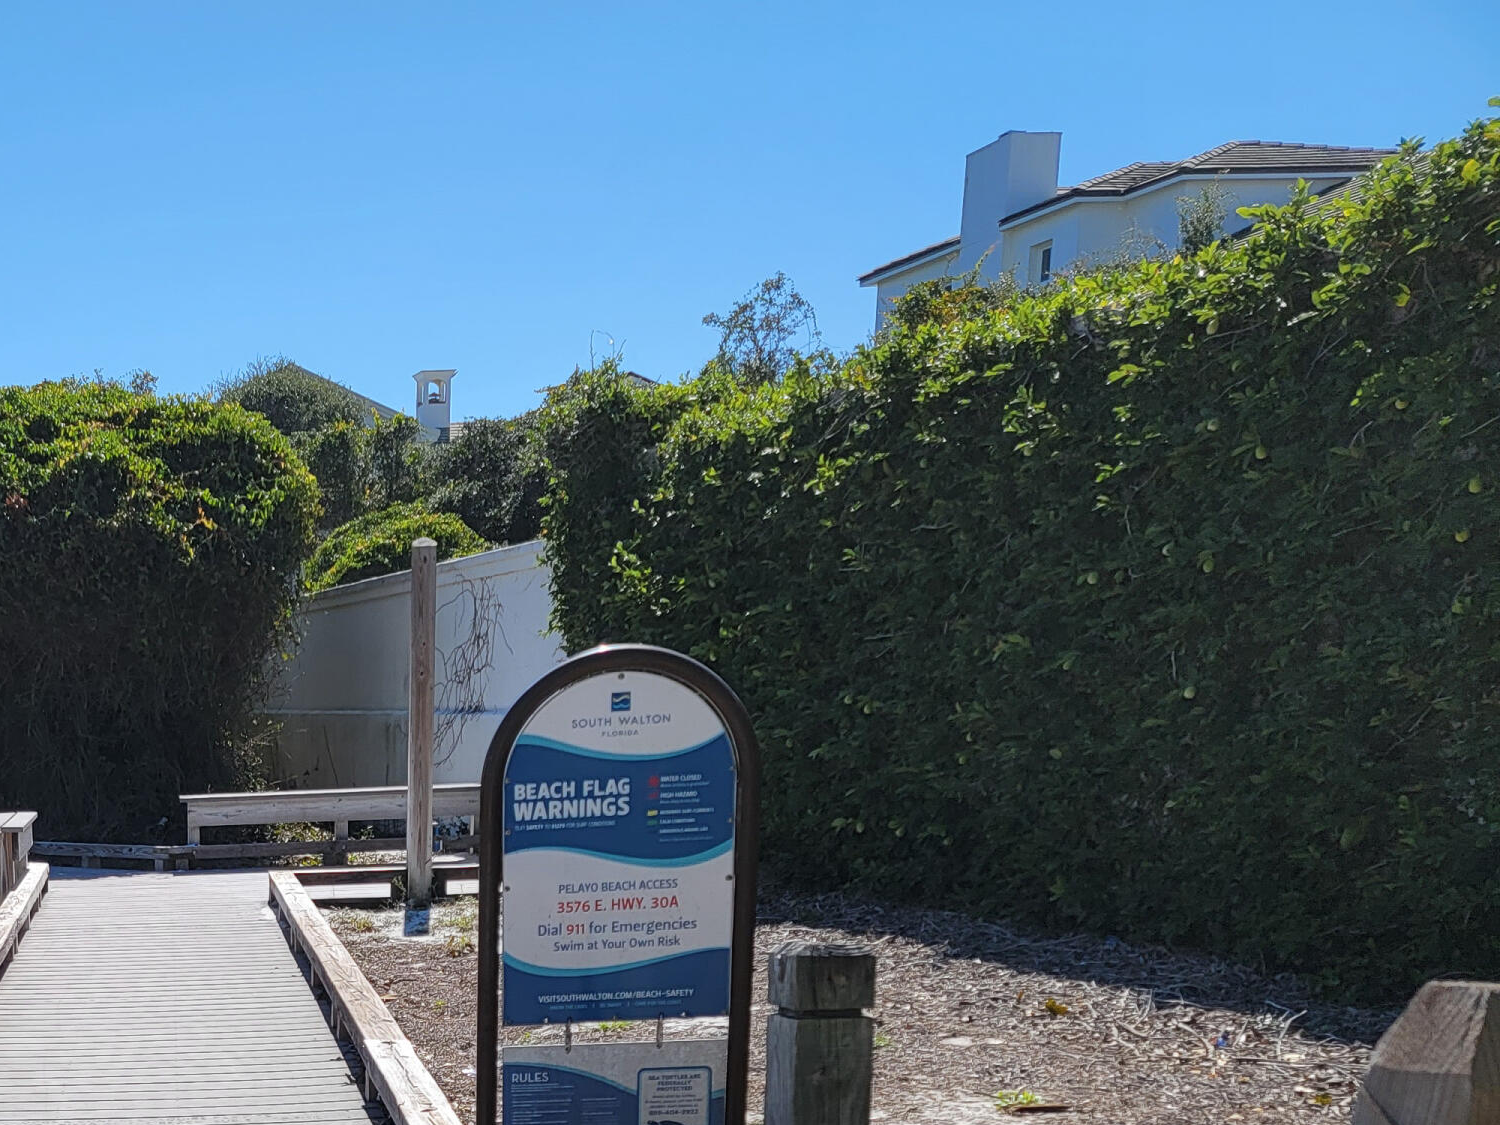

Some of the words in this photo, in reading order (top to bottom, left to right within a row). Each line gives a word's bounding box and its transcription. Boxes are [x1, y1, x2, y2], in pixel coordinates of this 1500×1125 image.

[572, 717, 612, 729] SOUTH
[618, 713, 671, 726] WALTON
[601, 729, 639, 737] FLORIDA
[514, 780, 576, 801] BEACH
[582, 777, 630, 797] FLAG
[513, 796, 630, 821] WARNINGS
[558, 882, 599, 894] PELAYO
[601, 880, 636, 892] BEACH
[638, 878, 678, 890] ACCESS
[557, 900, 590, 914] 3576
[594, 899, 607, 912] E.
[611, 896, 647, 911] HWY.
[650, 895, 679, 909] 30A
[538, 922, 562, 937] Dial
[566, 923, 585, 936] 911
[589, 920, 608, 934] for
[611, 916, 698, 935] Emergencies
[553, 940, 584, 952] Swim
[587, 939, 598, 950] at
[601, 938, 626, 950] Your
[629, 937, 654, 948] Own
[657, 935, 681, 947] Risk
[538, 988, 694, 1004] VISITSOUTHWALTON.COM/BEACH-SAFETY
[511, 1072, 549, 1083] RULES
